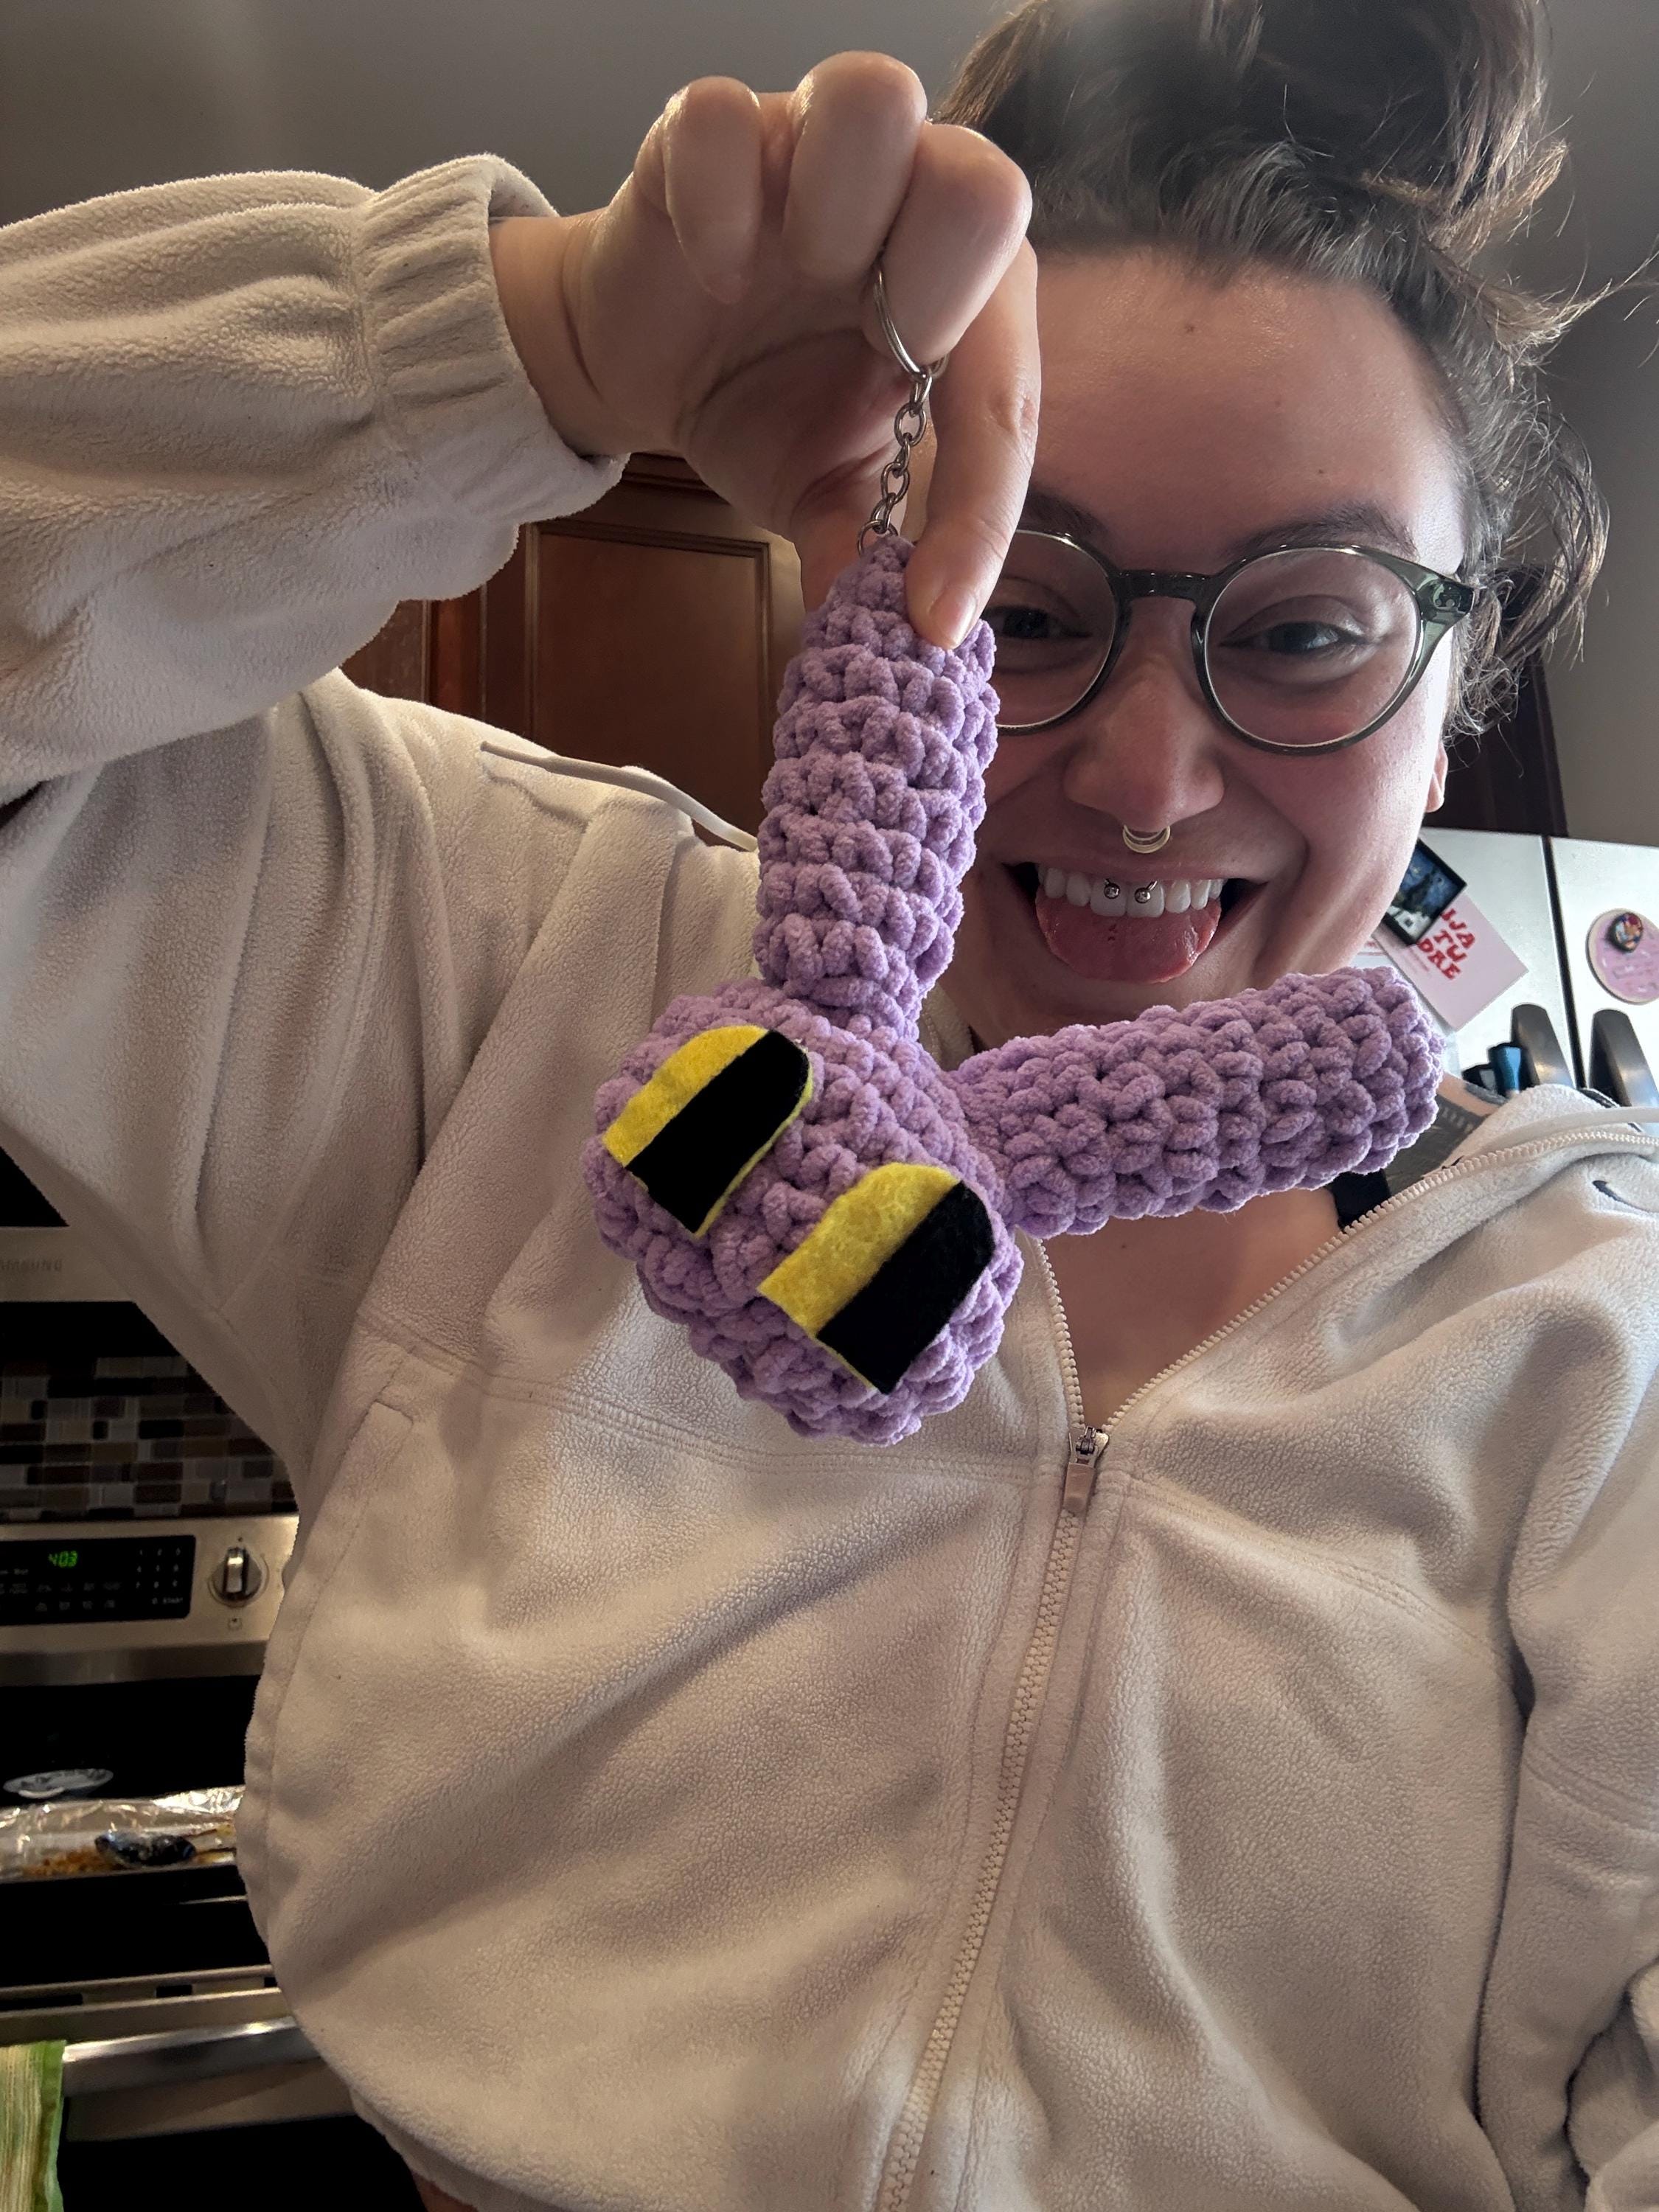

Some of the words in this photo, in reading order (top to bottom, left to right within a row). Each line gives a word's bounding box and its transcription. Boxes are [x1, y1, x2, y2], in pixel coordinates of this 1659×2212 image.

[1434, 930, 1467, 961] TU
[1441, 908, 1475, 949] IJA
[1418, 939, 1461, 979] DRE
[0, 1259, 62, 1272] AMSUNG
